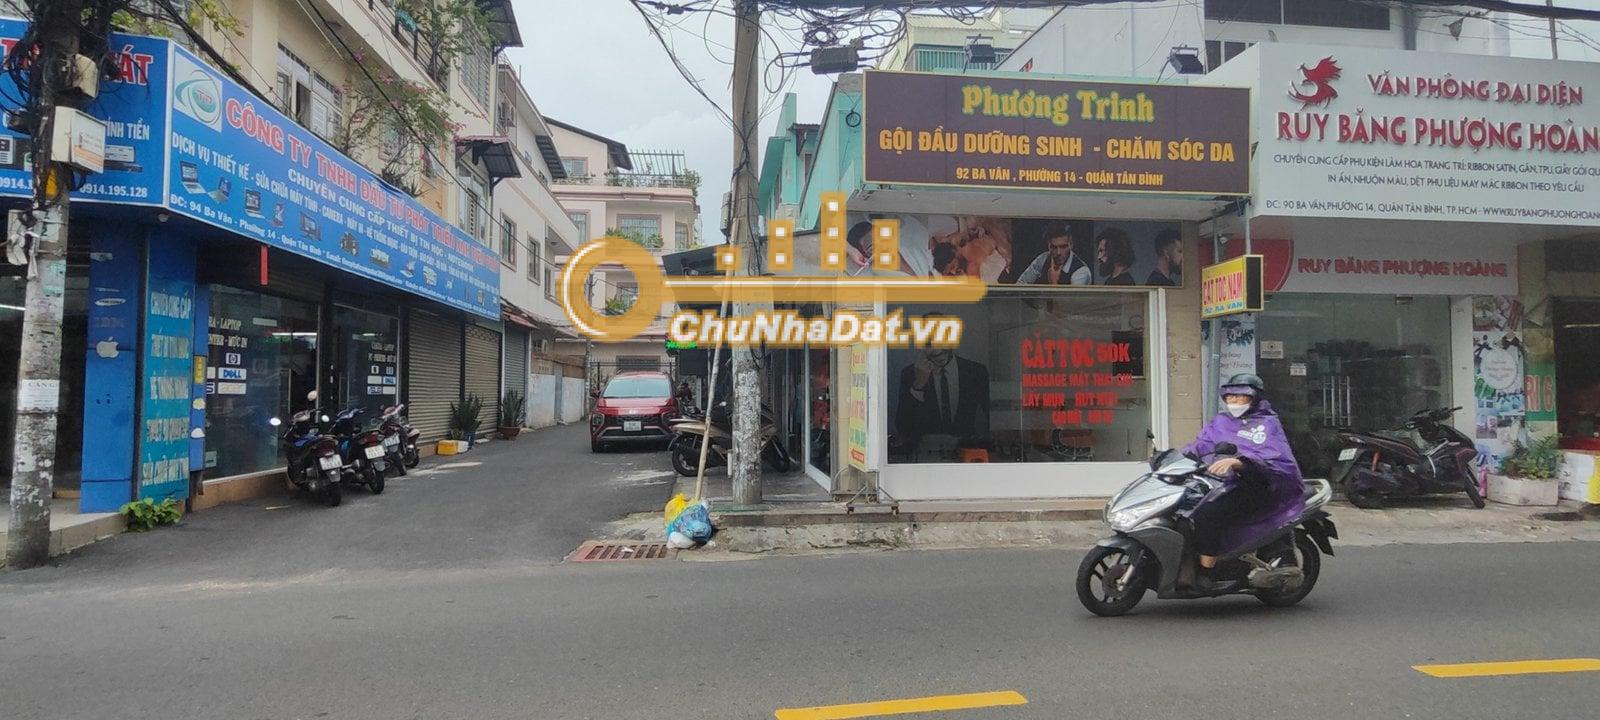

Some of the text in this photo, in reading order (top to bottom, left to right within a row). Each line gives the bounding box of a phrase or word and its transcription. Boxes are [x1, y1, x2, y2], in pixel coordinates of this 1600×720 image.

[1366, 69, 1583, 107] VĂN PHÒNG ĐẠI DIỆN
[961, 84, 1155, 126] Phương Trinh
[879, 126, 913, 155] GỘI
[917, 125, 958, 153] ĐẦU
[964, 129, 1030, 155] DƯỠNG
[1036, 135, 1082, 157] SINH
[1106, 136, 1162, 160] CHĂM
[1167, 137, 1204, 162] SÓC
[1210, 143, 1235, 162] DA
[1277, 107, 1600, 154] RUY BĂNG PHƯỢNG HOÀN
[172, 131, 196, 155] DỊCH
[198, 144, 210, 165] VỤ
[212, 150, 236, 175] THIẾT
[239, 163, 250, 181] KẾ
[226, 98, 285, 155] CÔNG
[288, 134, 312, 169] TY
[315, 150, 357, 195] TNHH
[1273, 153, 1306, 164] CHUYÊN
[1308, 155, 1331, 165] CUNG
[1404, 160, 1422, 169] HOA
[1424, 160, 1451, 170] TRANG
[956, 167, 970, 180] 92
[972, 168, 987, 180] BA
[989, 166, 1010, 180] VÂN
[1019, 167, 1061, 183] PHƯỜNG
[1064, 171, 1076, 183] 14
[1086, 170, 1114, 187] QUẬN
[1117, 171, 1136, 185] TÂN
[1139, 171, 1163, 186] BÌNH
[1461, 180, 1479, 188] MAY
[1530, 181, 1551, 191] THEO
[190, 201, 201, 213] 94
[204, 206, 215, 219] Ba
[287, 168, 336, 202] CHUYÊN
[339, 195, 365, 217] CUNG
[368, 210, 385, 226] CẤP
[1283, 200, 1294, 209] 90
[1296, 201, 1306, 209] BA
[1298, 256, 1508, 278] RUY BĂNG PHƯỢNG HOÀNG
[223, 370, 241, 378] DELL
